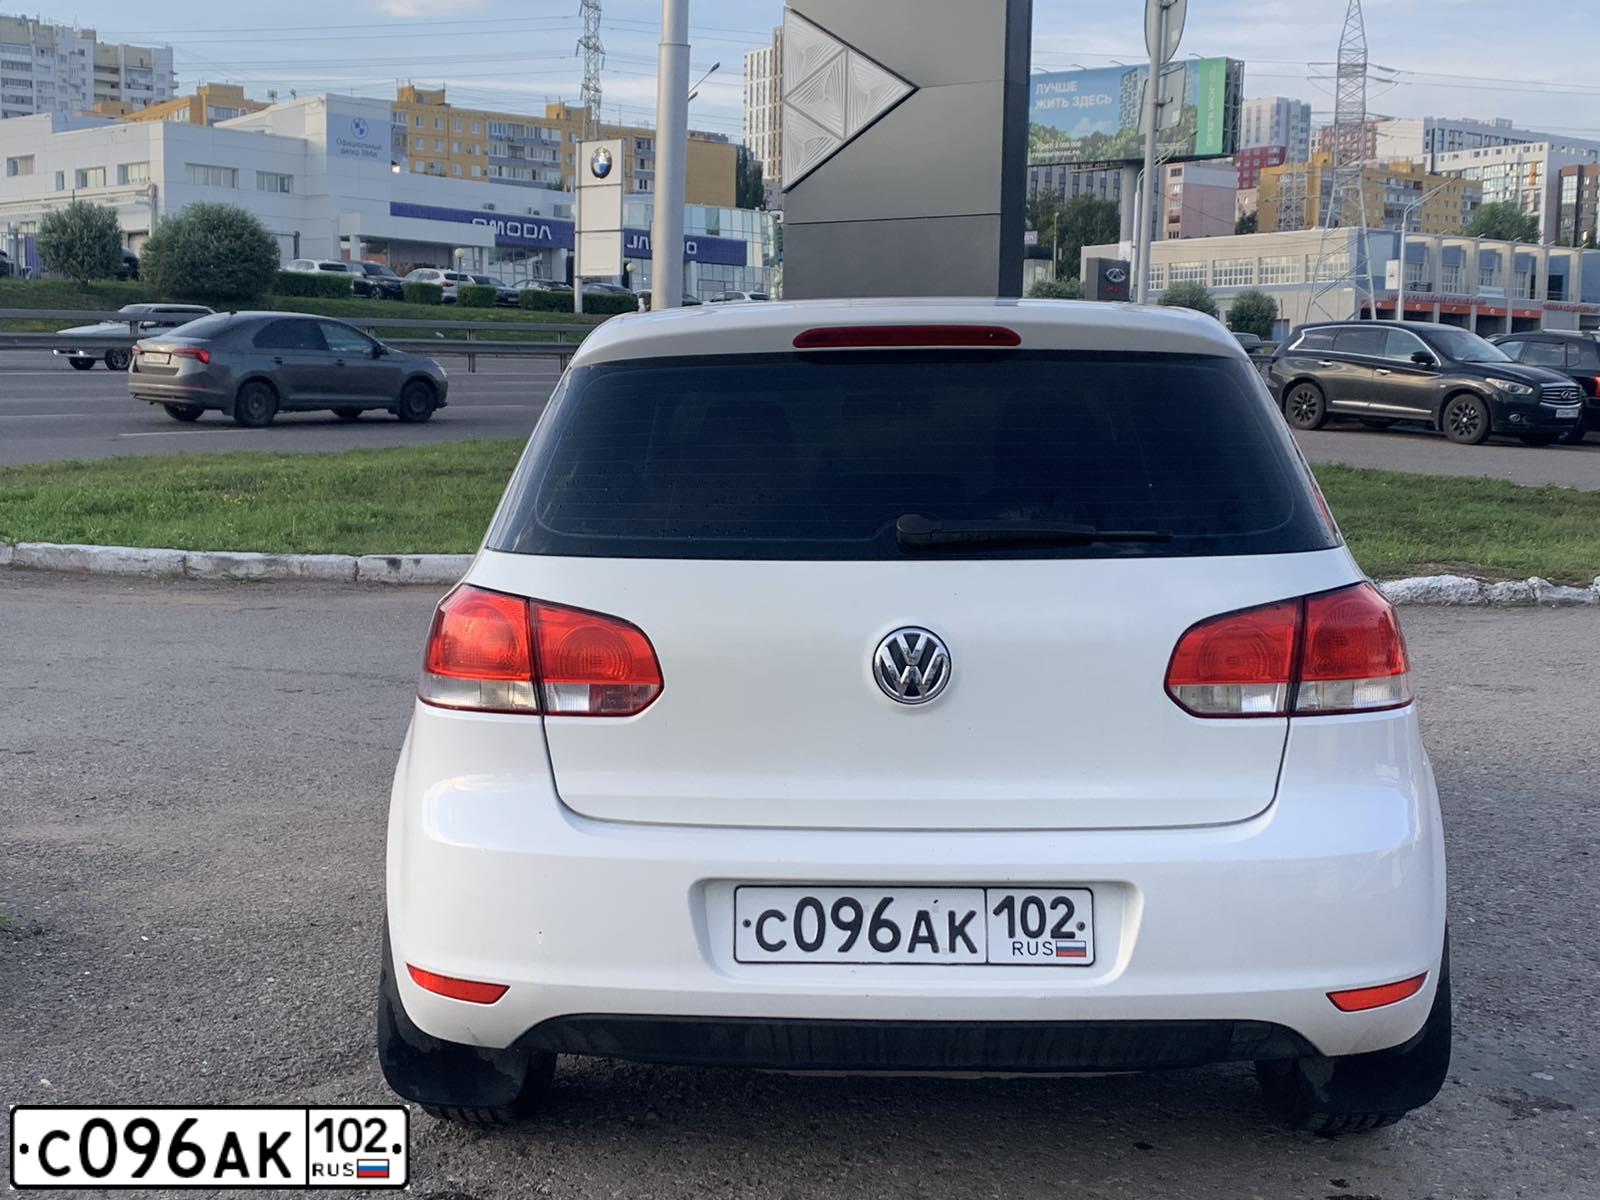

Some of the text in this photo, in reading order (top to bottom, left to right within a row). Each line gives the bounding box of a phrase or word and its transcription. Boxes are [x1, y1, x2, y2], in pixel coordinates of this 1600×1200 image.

[1034, 80, 1078, 96] ЛУЧШЕ
[1034, 94, 1113, 110] ЖИТЬ ЗДЕСЬ
[992, 895, 1077, 940] 102
[1012, 940, 1054, 956] RUS
